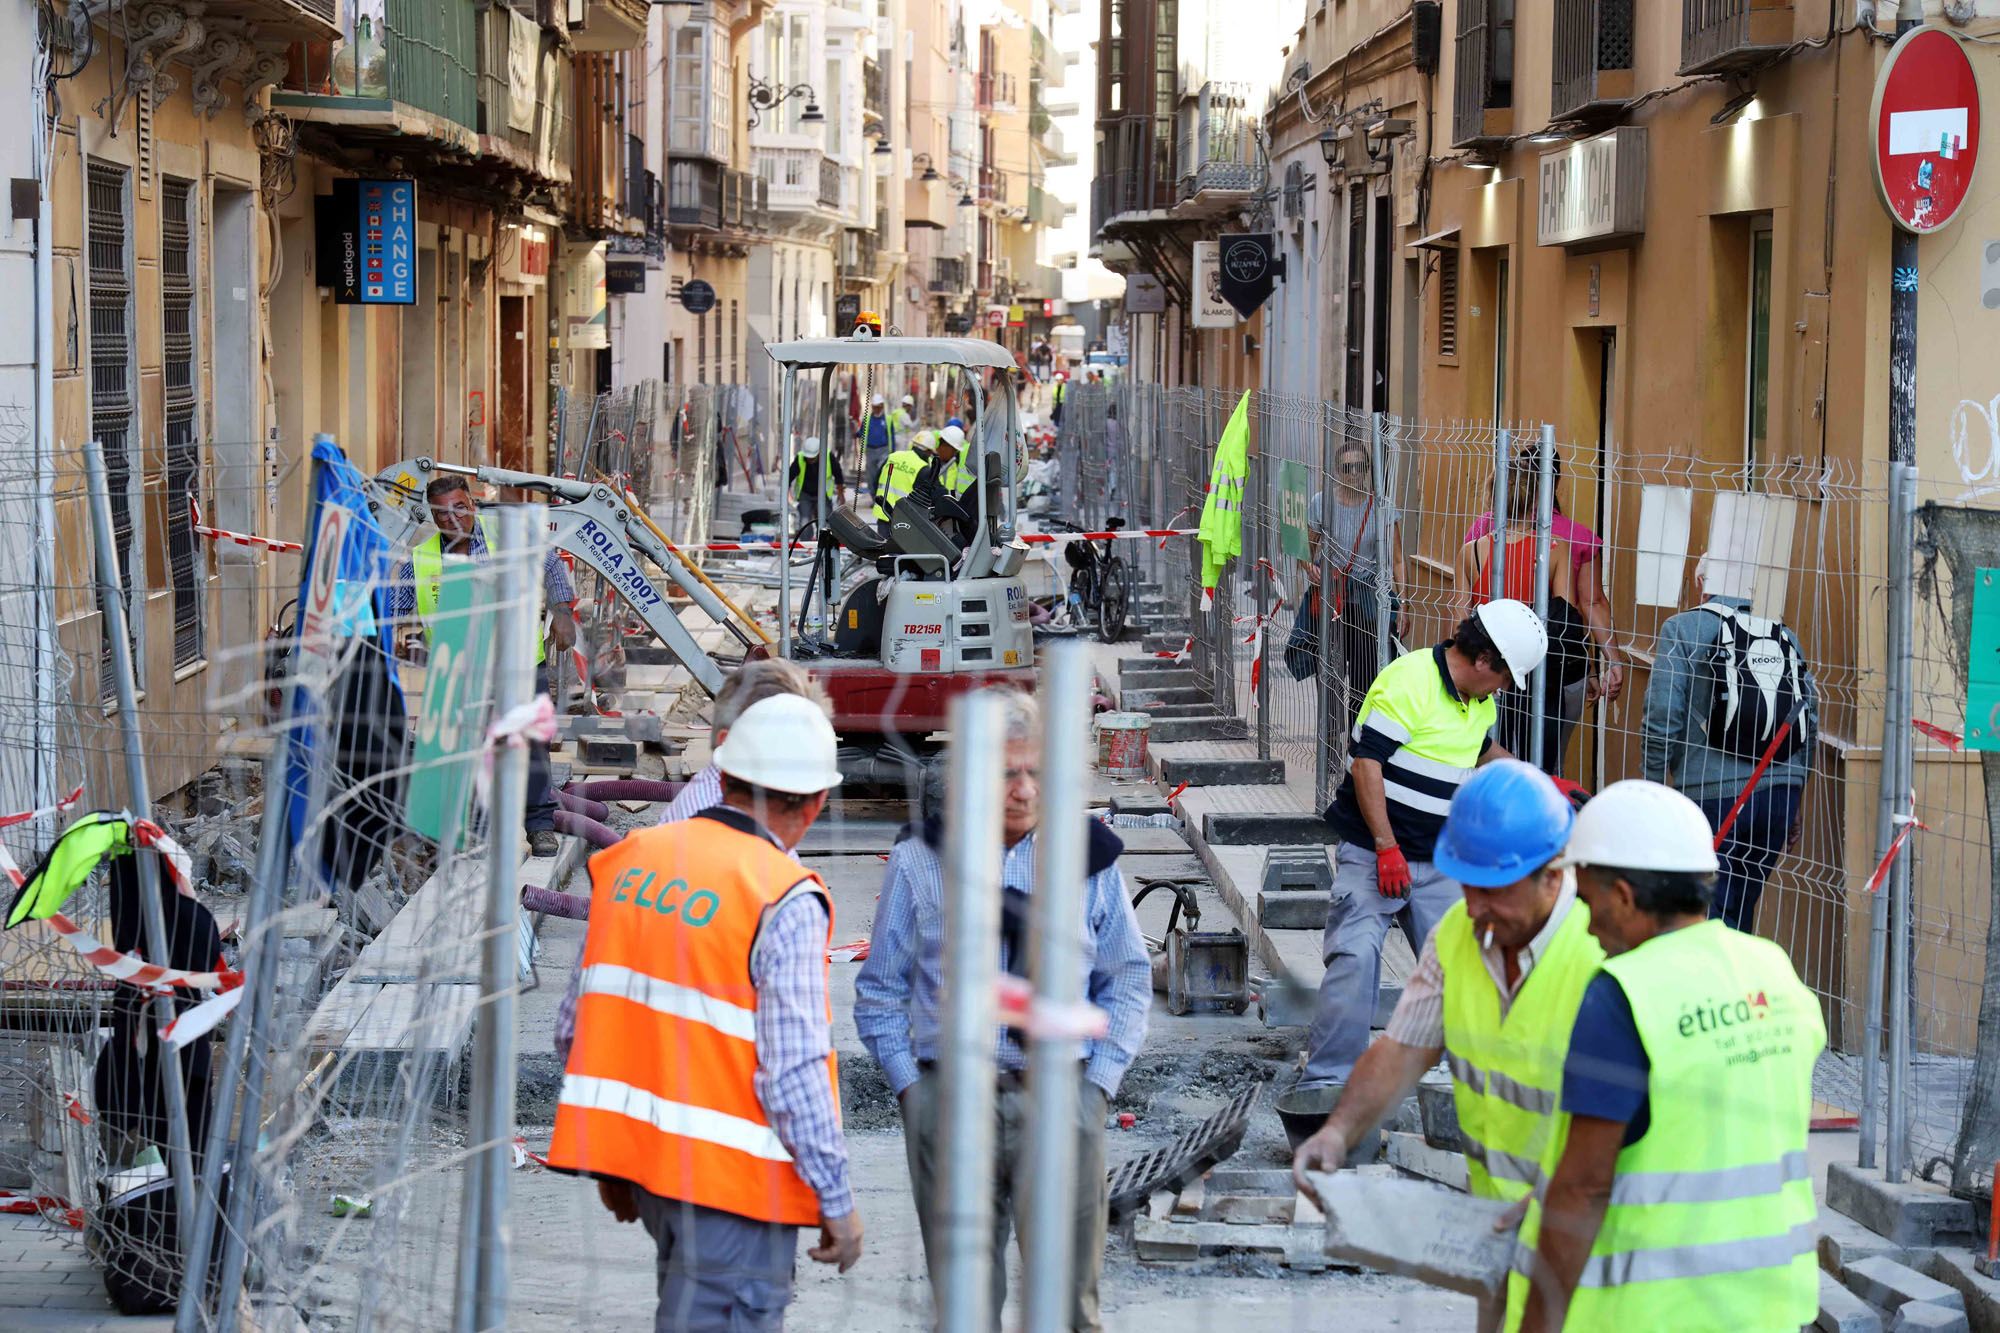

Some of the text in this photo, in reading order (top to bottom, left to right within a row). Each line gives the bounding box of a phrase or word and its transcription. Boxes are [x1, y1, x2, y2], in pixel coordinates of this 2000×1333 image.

[1542, 145, 1611, 235] FARMACIA
[343, 232, 355, 287] quickgold
[392, 188, 408, 297] CHANGE
[1201, 308, 1233, 316] ÁLAMOS
[576, 529, 587, 546] Exc.
[588, 544, 603, 562] Rola
[602, 559, 615, 574] 628
[613, 572, 622, 583] 65
[621, 582, 629, 592] 16
[628, 591, 637, 601] 16
[639, 602, 649, 614] 30
[582, 520, 661, 605] ROLA 2007
[904, 624, 942, 634] TB215R
[1678, 997, 1751, 1038] ética
